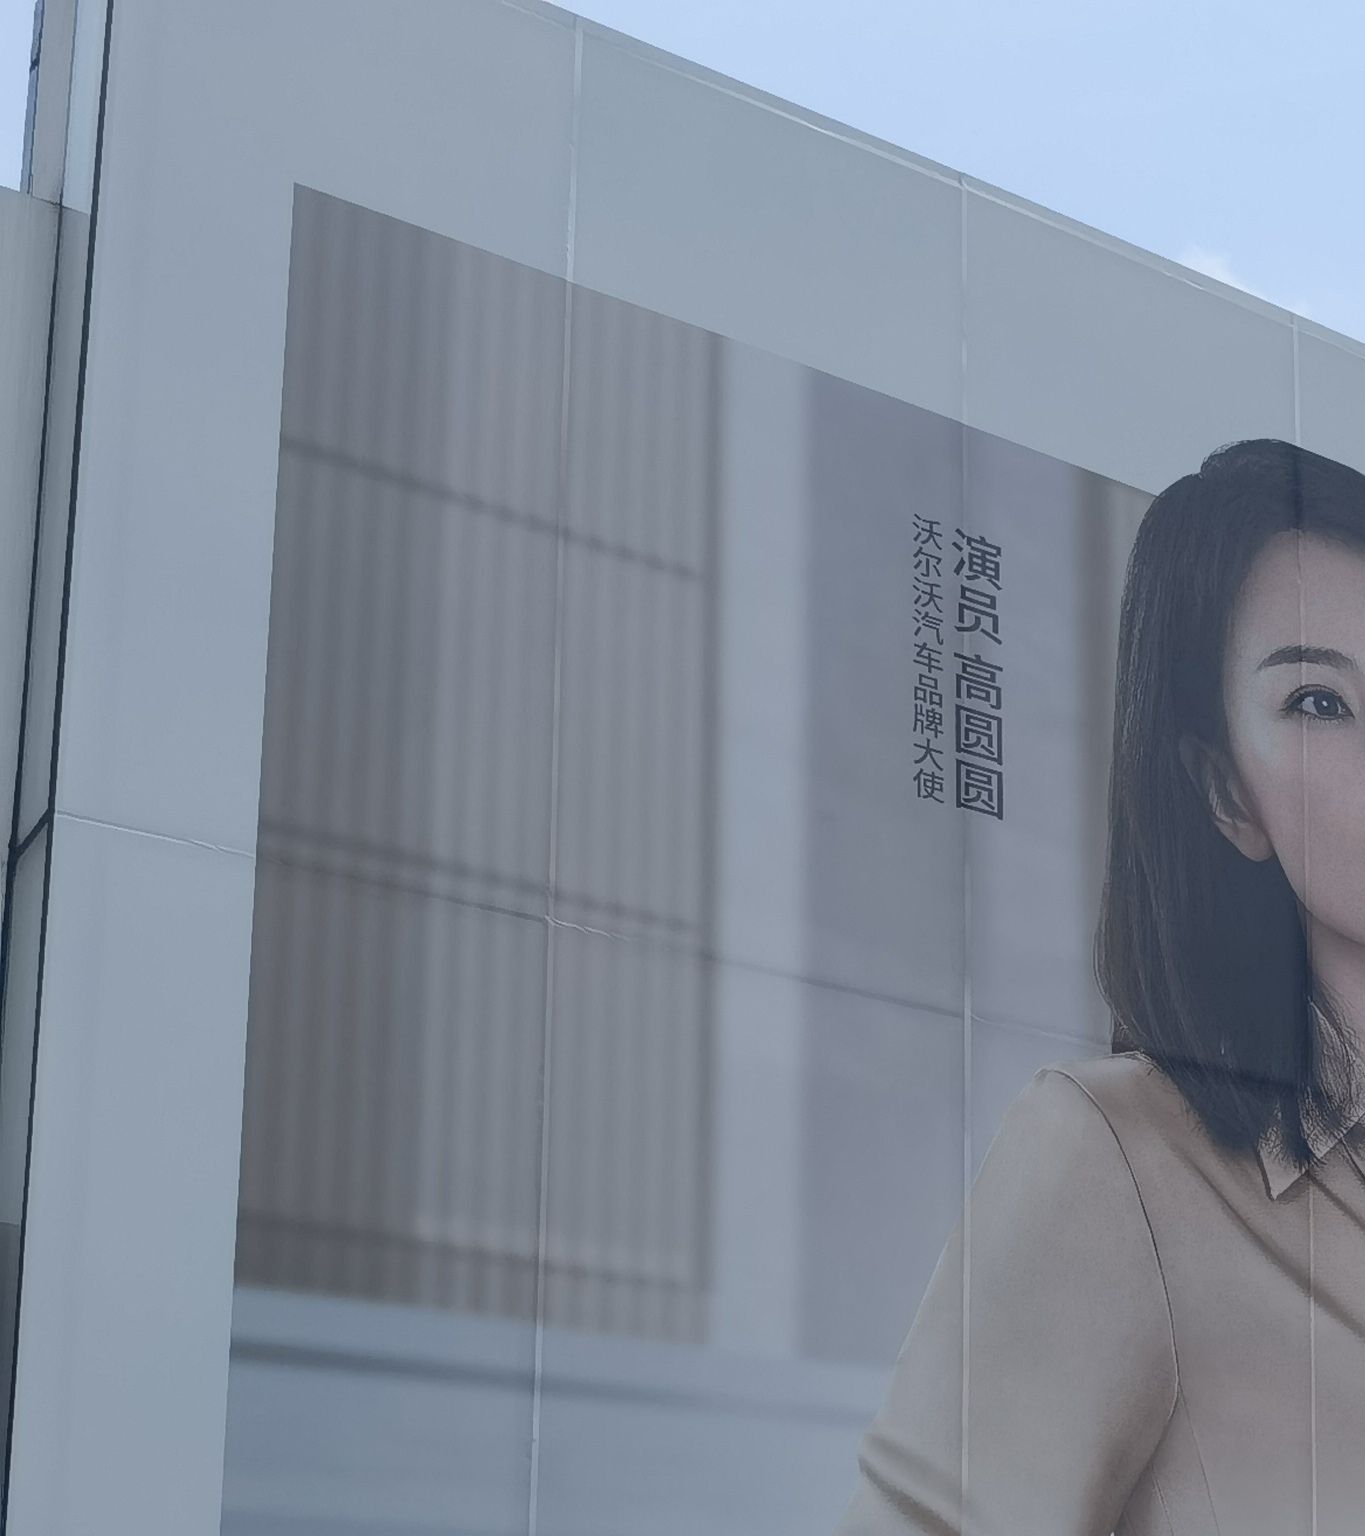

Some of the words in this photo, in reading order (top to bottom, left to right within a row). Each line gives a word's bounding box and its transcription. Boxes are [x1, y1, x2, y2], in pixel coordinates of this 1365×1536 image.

[912, 513, 944, 804] 沃尔沃汽车品牌大使
[952, 528, 1002, 645] 演员
[953, 652, 1004, 821] 高圆圆
